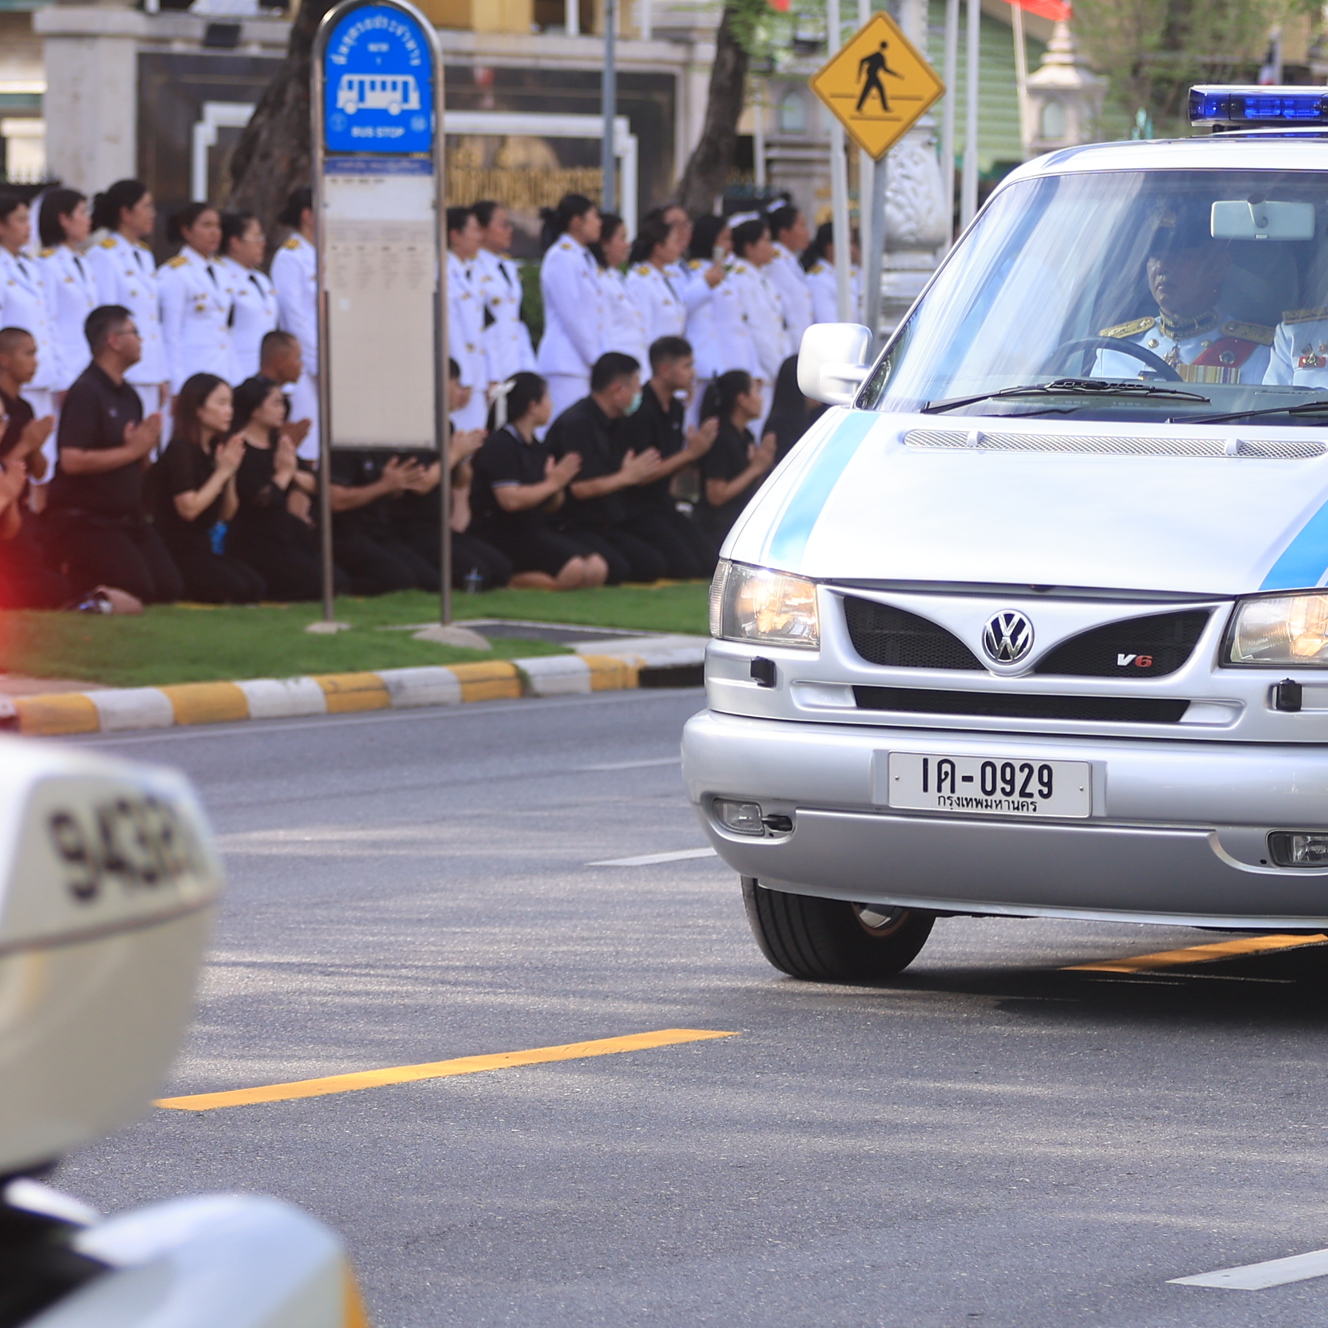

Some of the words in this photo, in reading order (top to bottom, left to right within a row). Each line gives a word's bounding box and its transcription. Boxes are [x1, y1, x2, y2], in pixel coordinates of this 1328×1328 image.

[350, 125, 374, 139] BUS
[376, 126, 405, 139] STOP
[1116, 653, 1154, 669] V6
[937, 794, 1038, 813] กรุงเทพมหานคร
